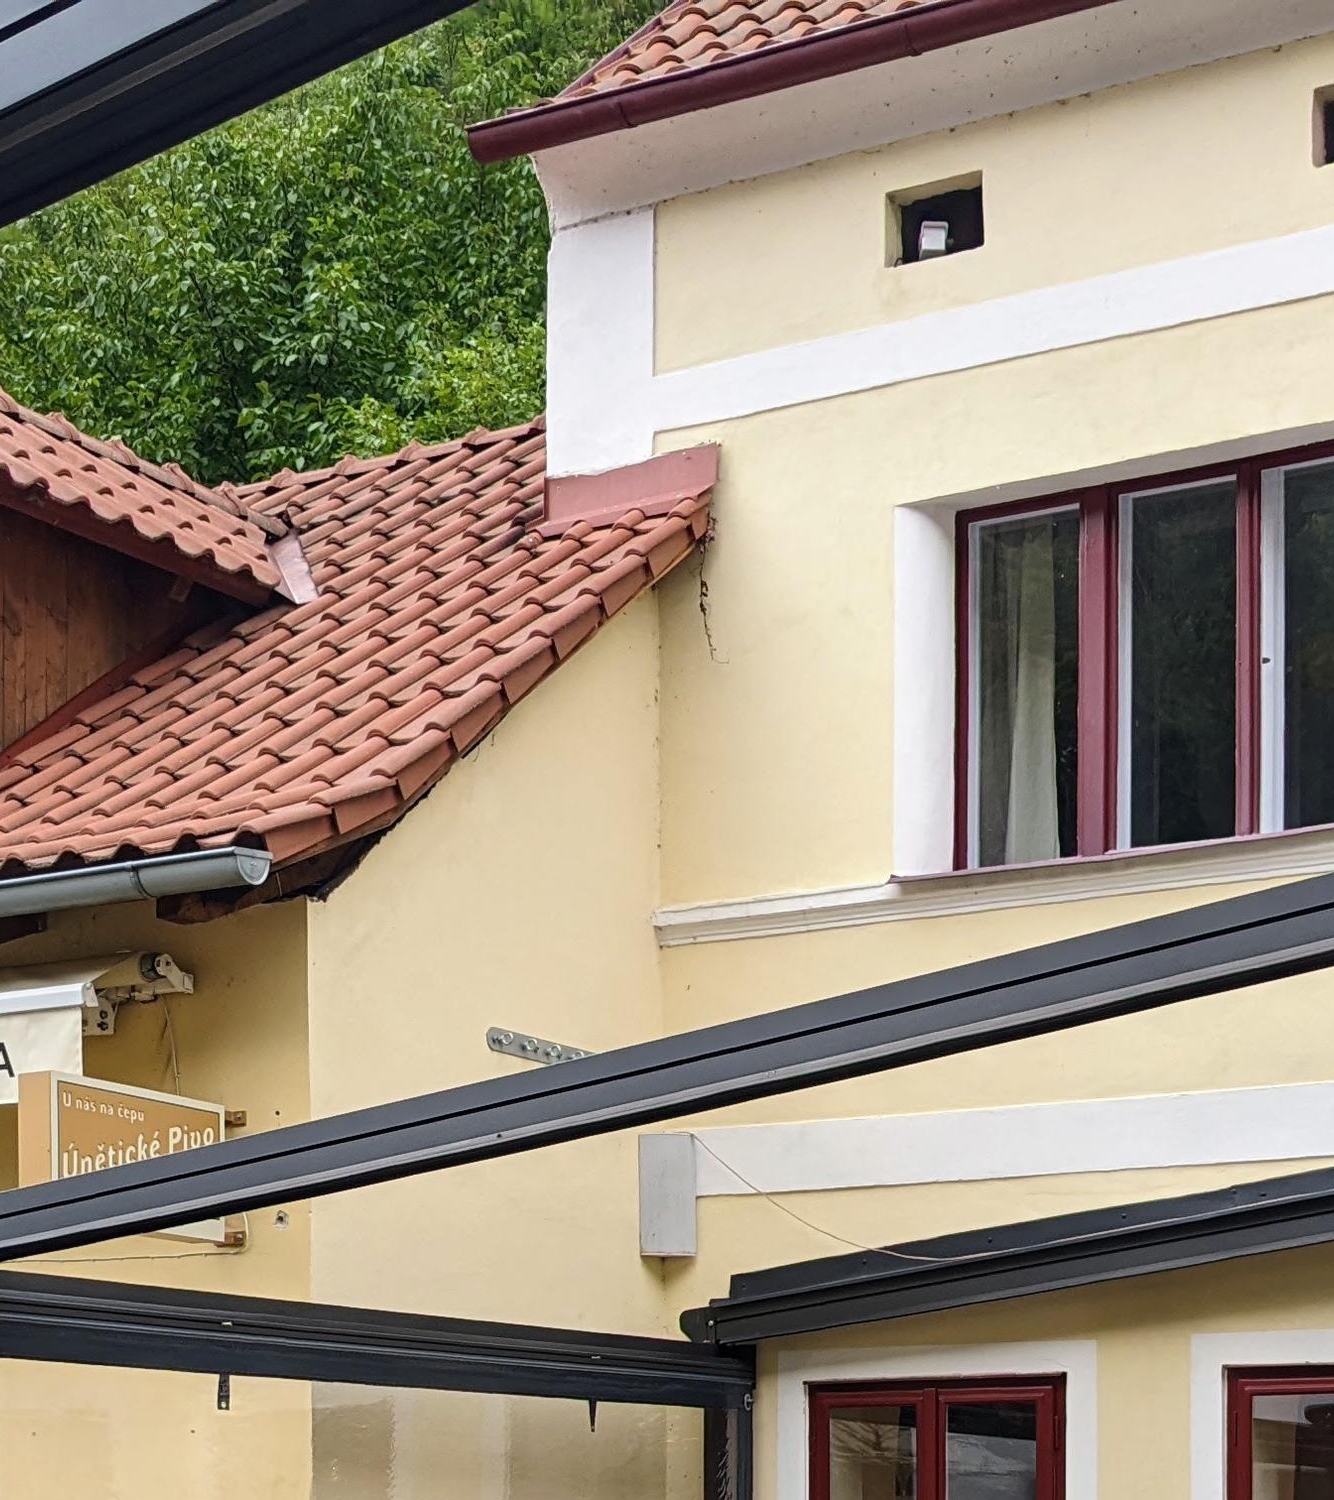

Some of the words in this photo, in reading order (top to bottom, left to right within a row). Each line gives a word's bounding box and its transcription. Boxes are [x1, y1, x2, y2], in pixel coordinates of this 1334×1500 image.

[63, 1091, 72, 1107] U
[75, 1097, 97, 1113] nás
[100, 1102, 114, 1117] na
[168, 1126, 215, 1155] Pivo
